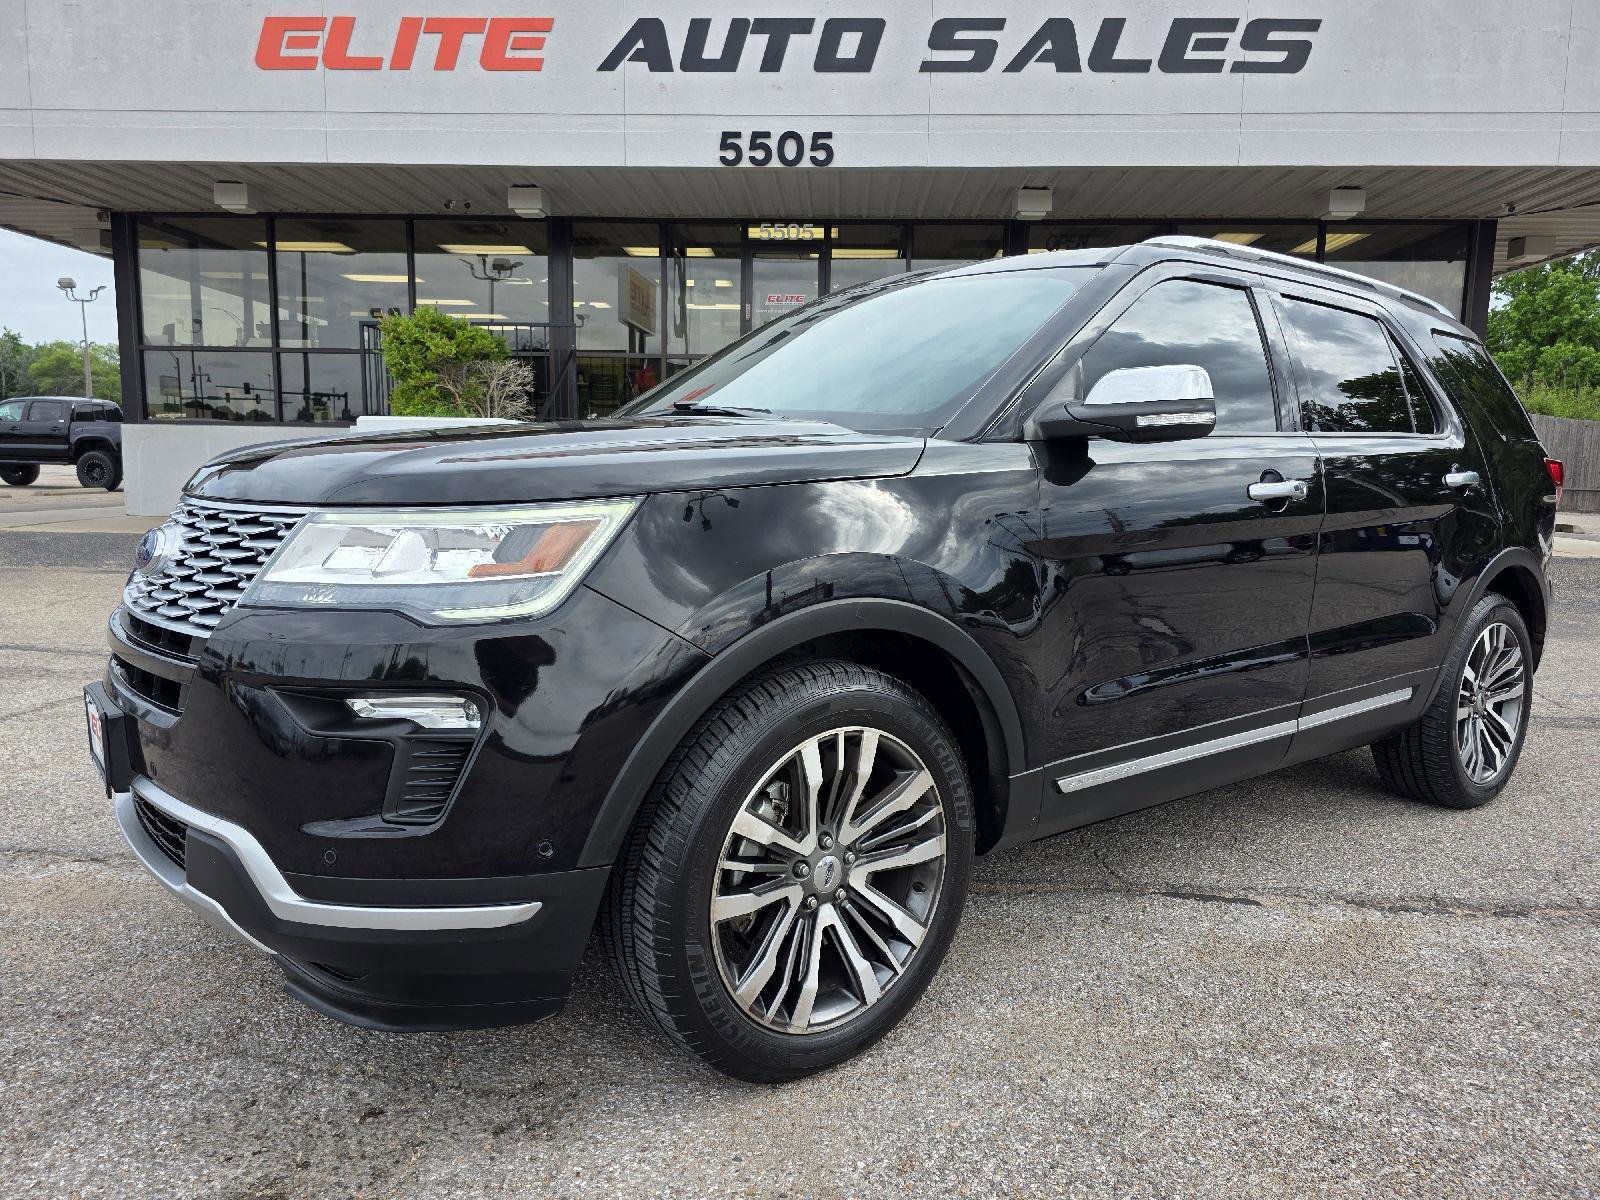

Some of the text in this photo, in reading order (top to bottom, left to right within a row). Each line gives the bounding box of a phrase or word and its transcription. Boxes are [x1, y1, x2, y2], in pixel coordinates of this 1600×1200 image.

[255, 17, 1322, 74] ELITE AUTO SALES
[719, 130, 834, 167] 5505
[760, 223, 814, 241] 5505
[767, 294, 806, 303] ELITE
